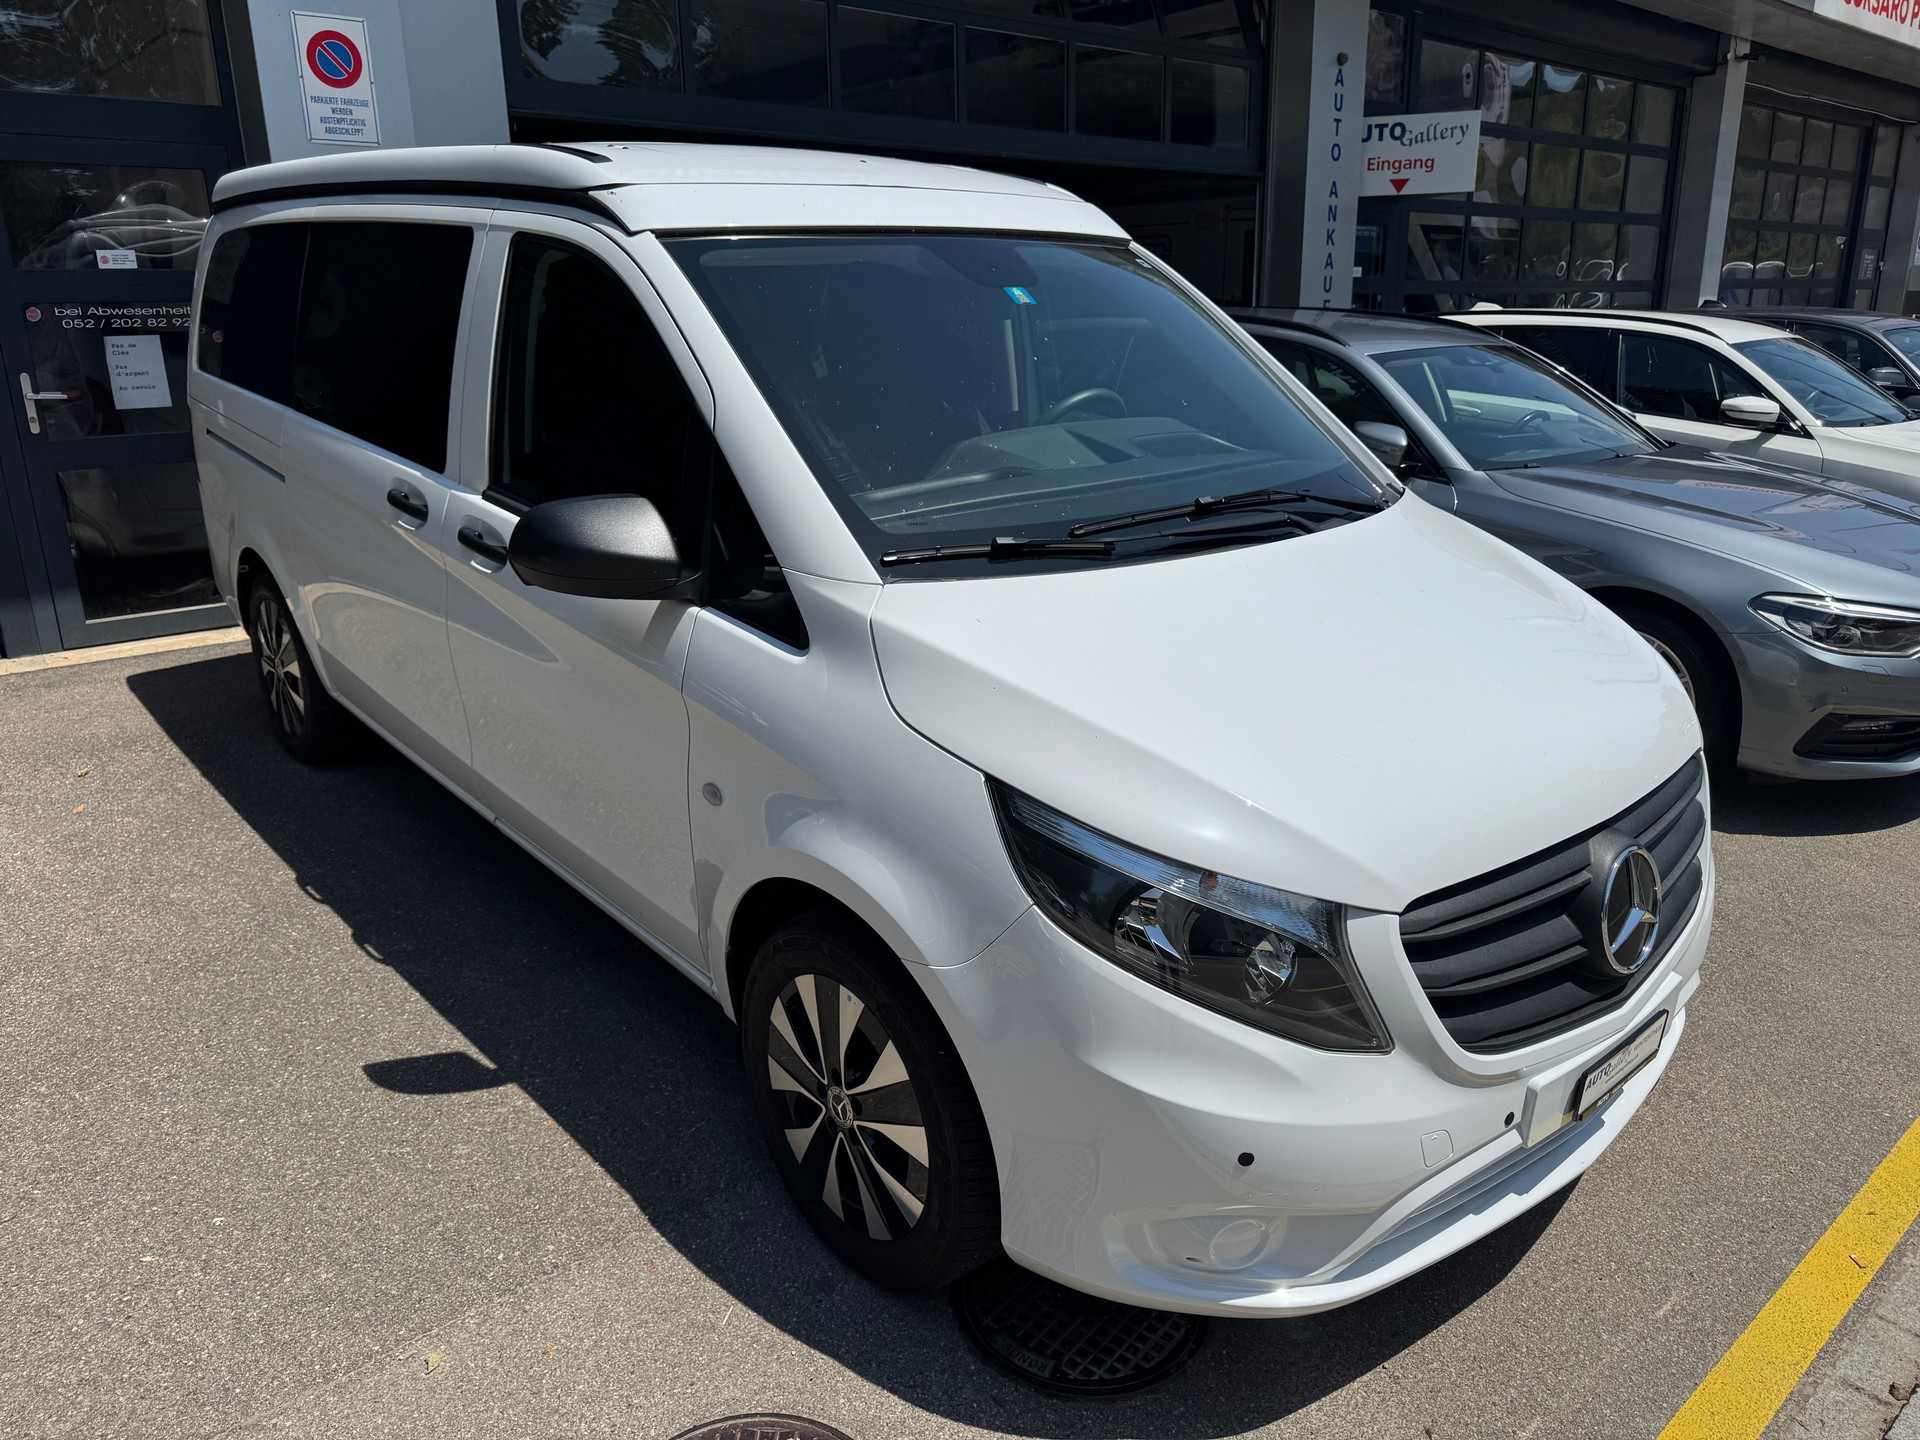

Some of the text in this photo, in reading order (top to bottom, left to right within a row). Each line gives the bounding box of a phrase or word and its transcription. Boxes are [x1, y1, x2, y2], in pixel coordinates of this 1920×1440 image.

[310, 95, 370, 108] PARKIERTE FAHRZEUGE
[331, 107, 353, 116] WERDEN
[1331, 68, 1344, 161] AUTO
[320, 116, 367, 127] KOSTENPFLICHTIG
[324, 126, 364, 136] ABGESCHLEPPT
[1361, 121, 1469, 147] UTO Gallery
[1367, 157, 1434, 174] Eingang
[54, 306, 191, 316] bei Abwesenheit
[62, 319, 95, 329] 052
[111, 318, 142, 328] 202
[147, 318, 168, 328] 82
[172, 317, 191, 327] 92
[1585, 1063, 1612, 1092] AUTO
